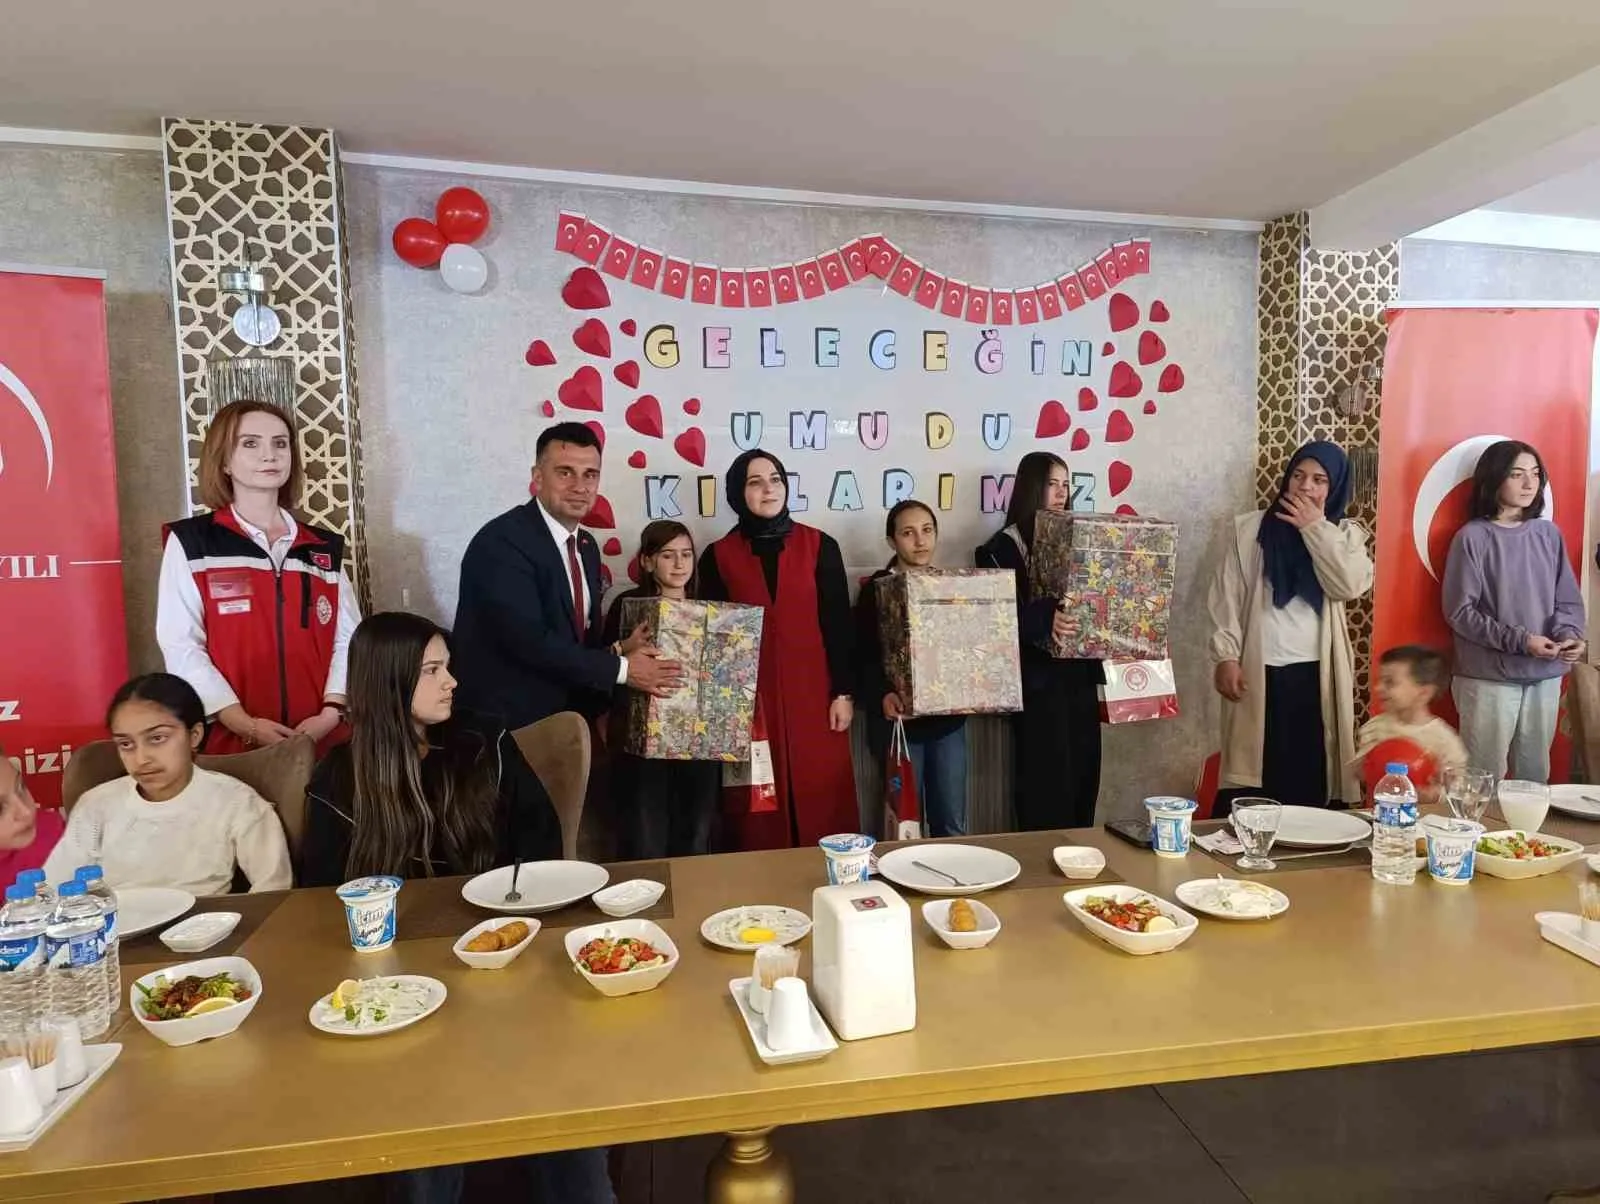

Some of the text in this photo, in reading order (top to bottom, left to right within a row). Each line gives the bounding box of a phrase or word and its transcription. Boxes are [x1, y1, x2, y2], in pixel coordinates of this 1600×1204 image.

[643, 324, 1092, 377] GELECEĞİN
[730, 410, 1011, 451] UMUDU
[644, 468, 1096, 520] KILARIMZ
